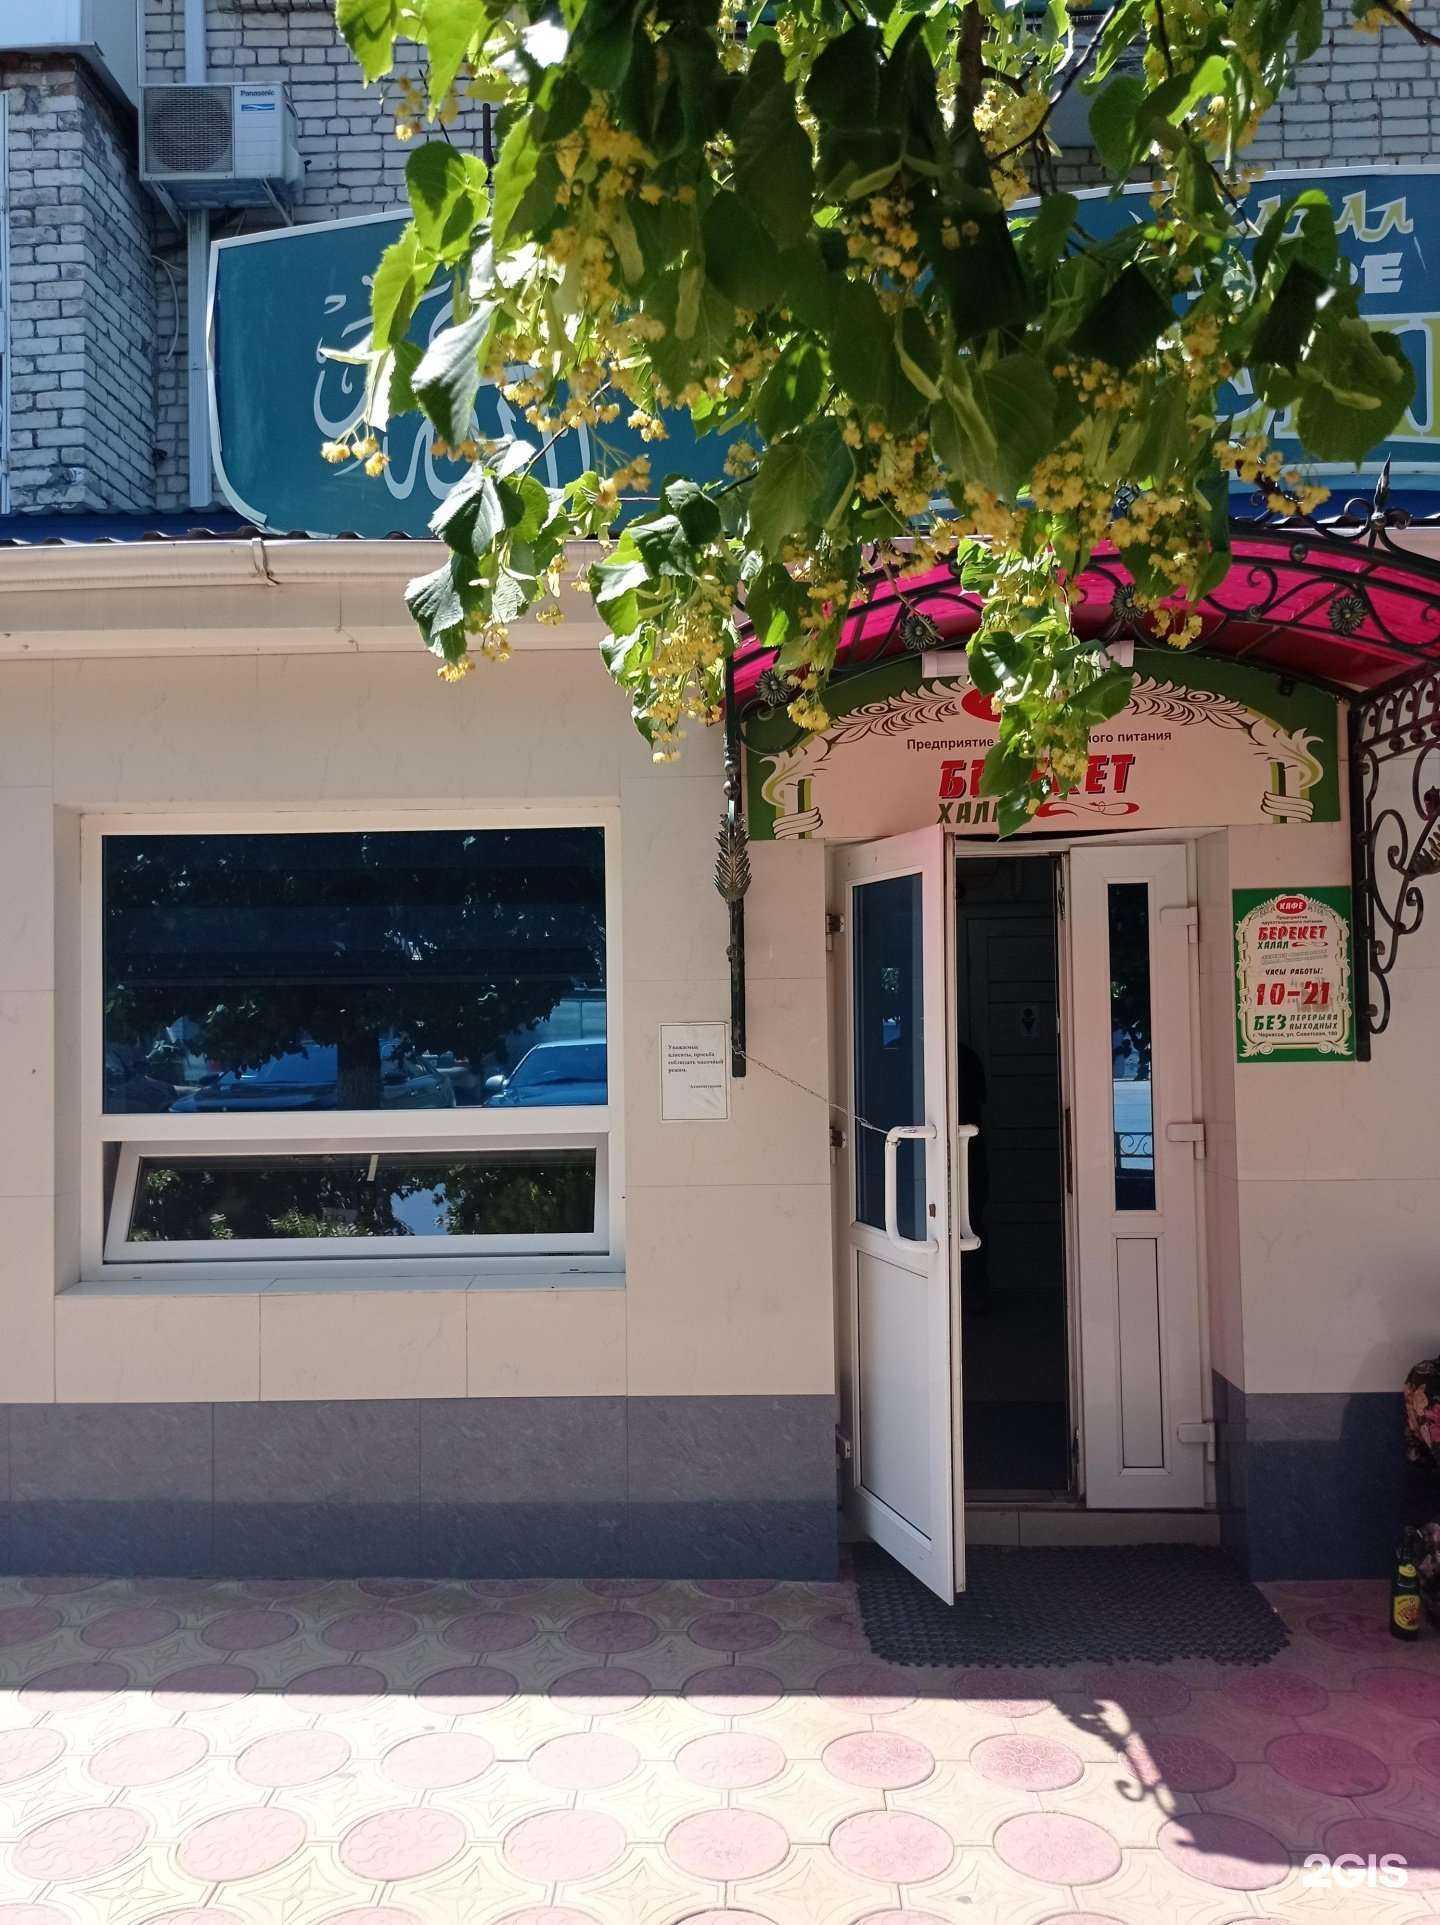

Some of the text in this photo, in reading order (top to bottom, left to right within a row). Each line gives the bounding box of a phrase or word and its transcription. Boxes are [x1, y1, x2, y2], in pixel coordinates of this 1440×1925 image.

[240, 89, 274, 97] Panasonic
[906, 738, 995, 751] Предприятие
[1117, 730, 1172, 743] питания
[1280, 902, 1303, 910] КАФЕ
[1258, 926, 1327, 941] БЕРЕКЕТ
[1257, 940, 1289, 950] ХАЛАЛ
[1265, 967, 1324, 976] ЧАСЫ РАБОТЫ:
[1254, 1014, 1287, 1031] БЕЗ
[1289, 1022, 1338, 1030] ВЫХОДНЫХ
